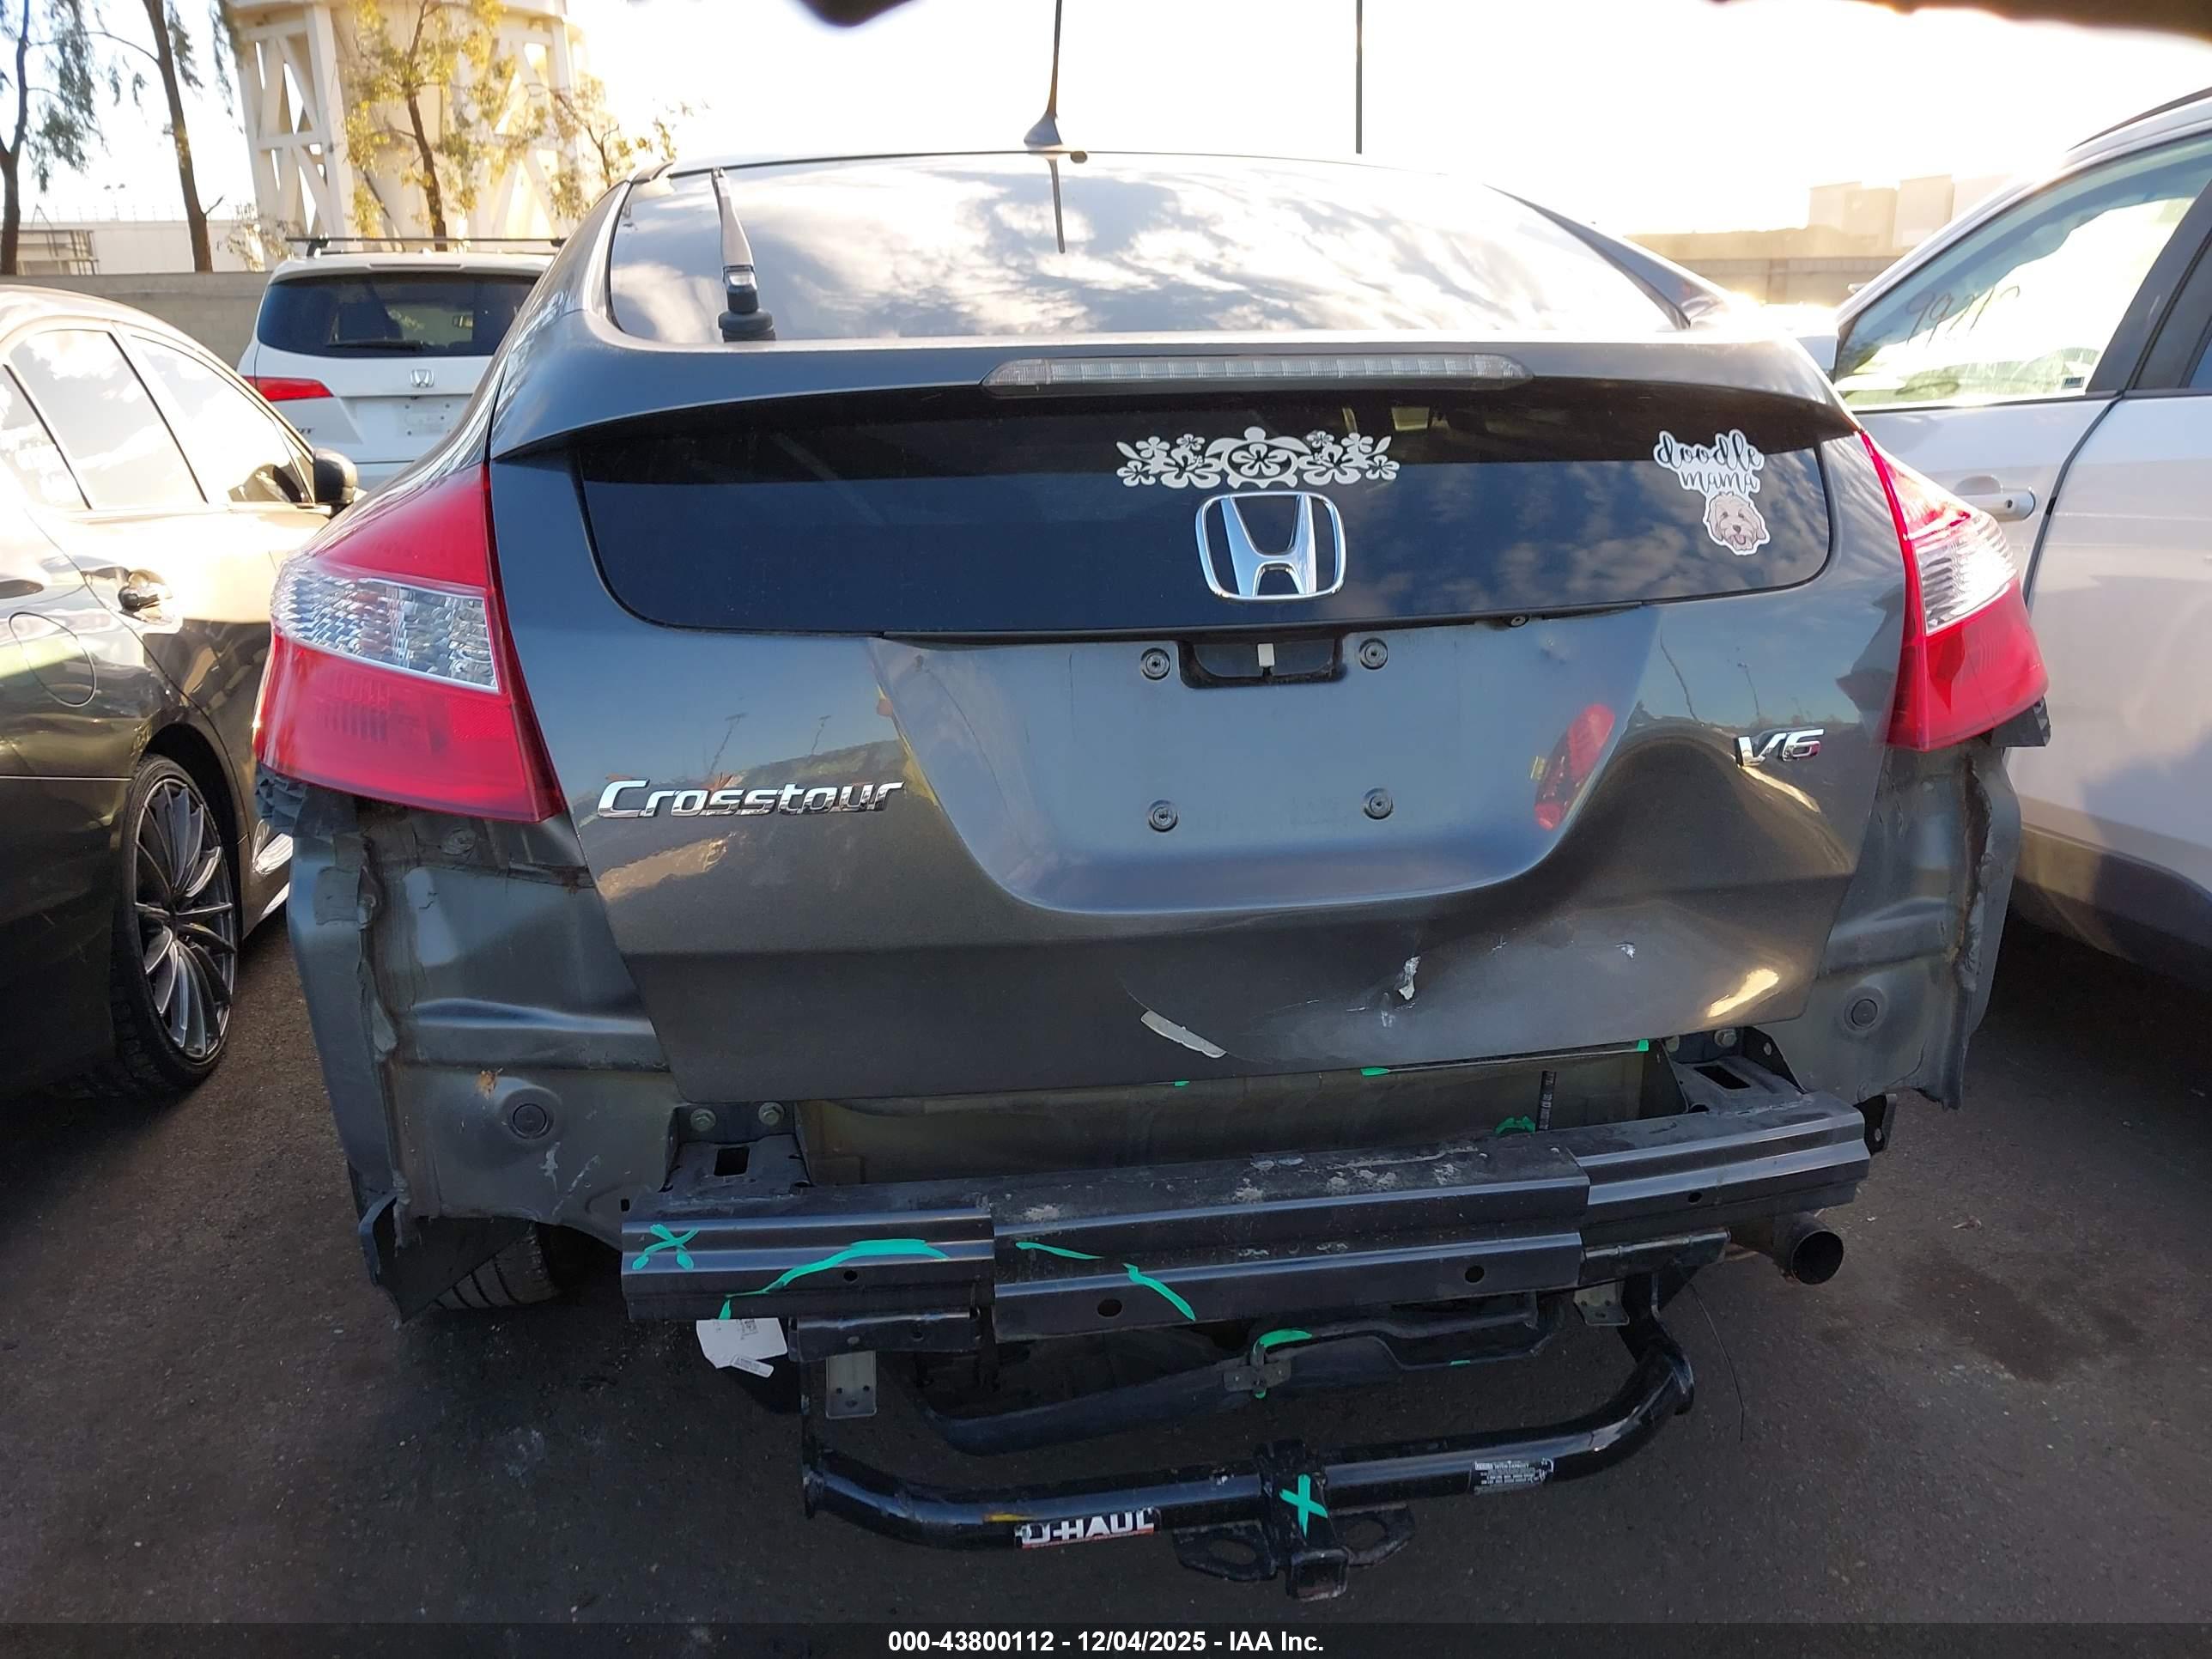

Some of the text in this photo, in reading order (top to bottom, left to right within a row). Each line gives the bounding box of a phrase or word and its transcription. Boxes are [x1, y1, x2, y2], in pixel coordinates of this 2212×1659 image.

[1656, 432, 1763, 472] doodle
[1680, 471, 1760, 494] mama
[1736, 728, 1824, 767] V6
[598, 778, 903, 818] Crosstour
[1018, 1507, 1156, 1546] U-HAUL
